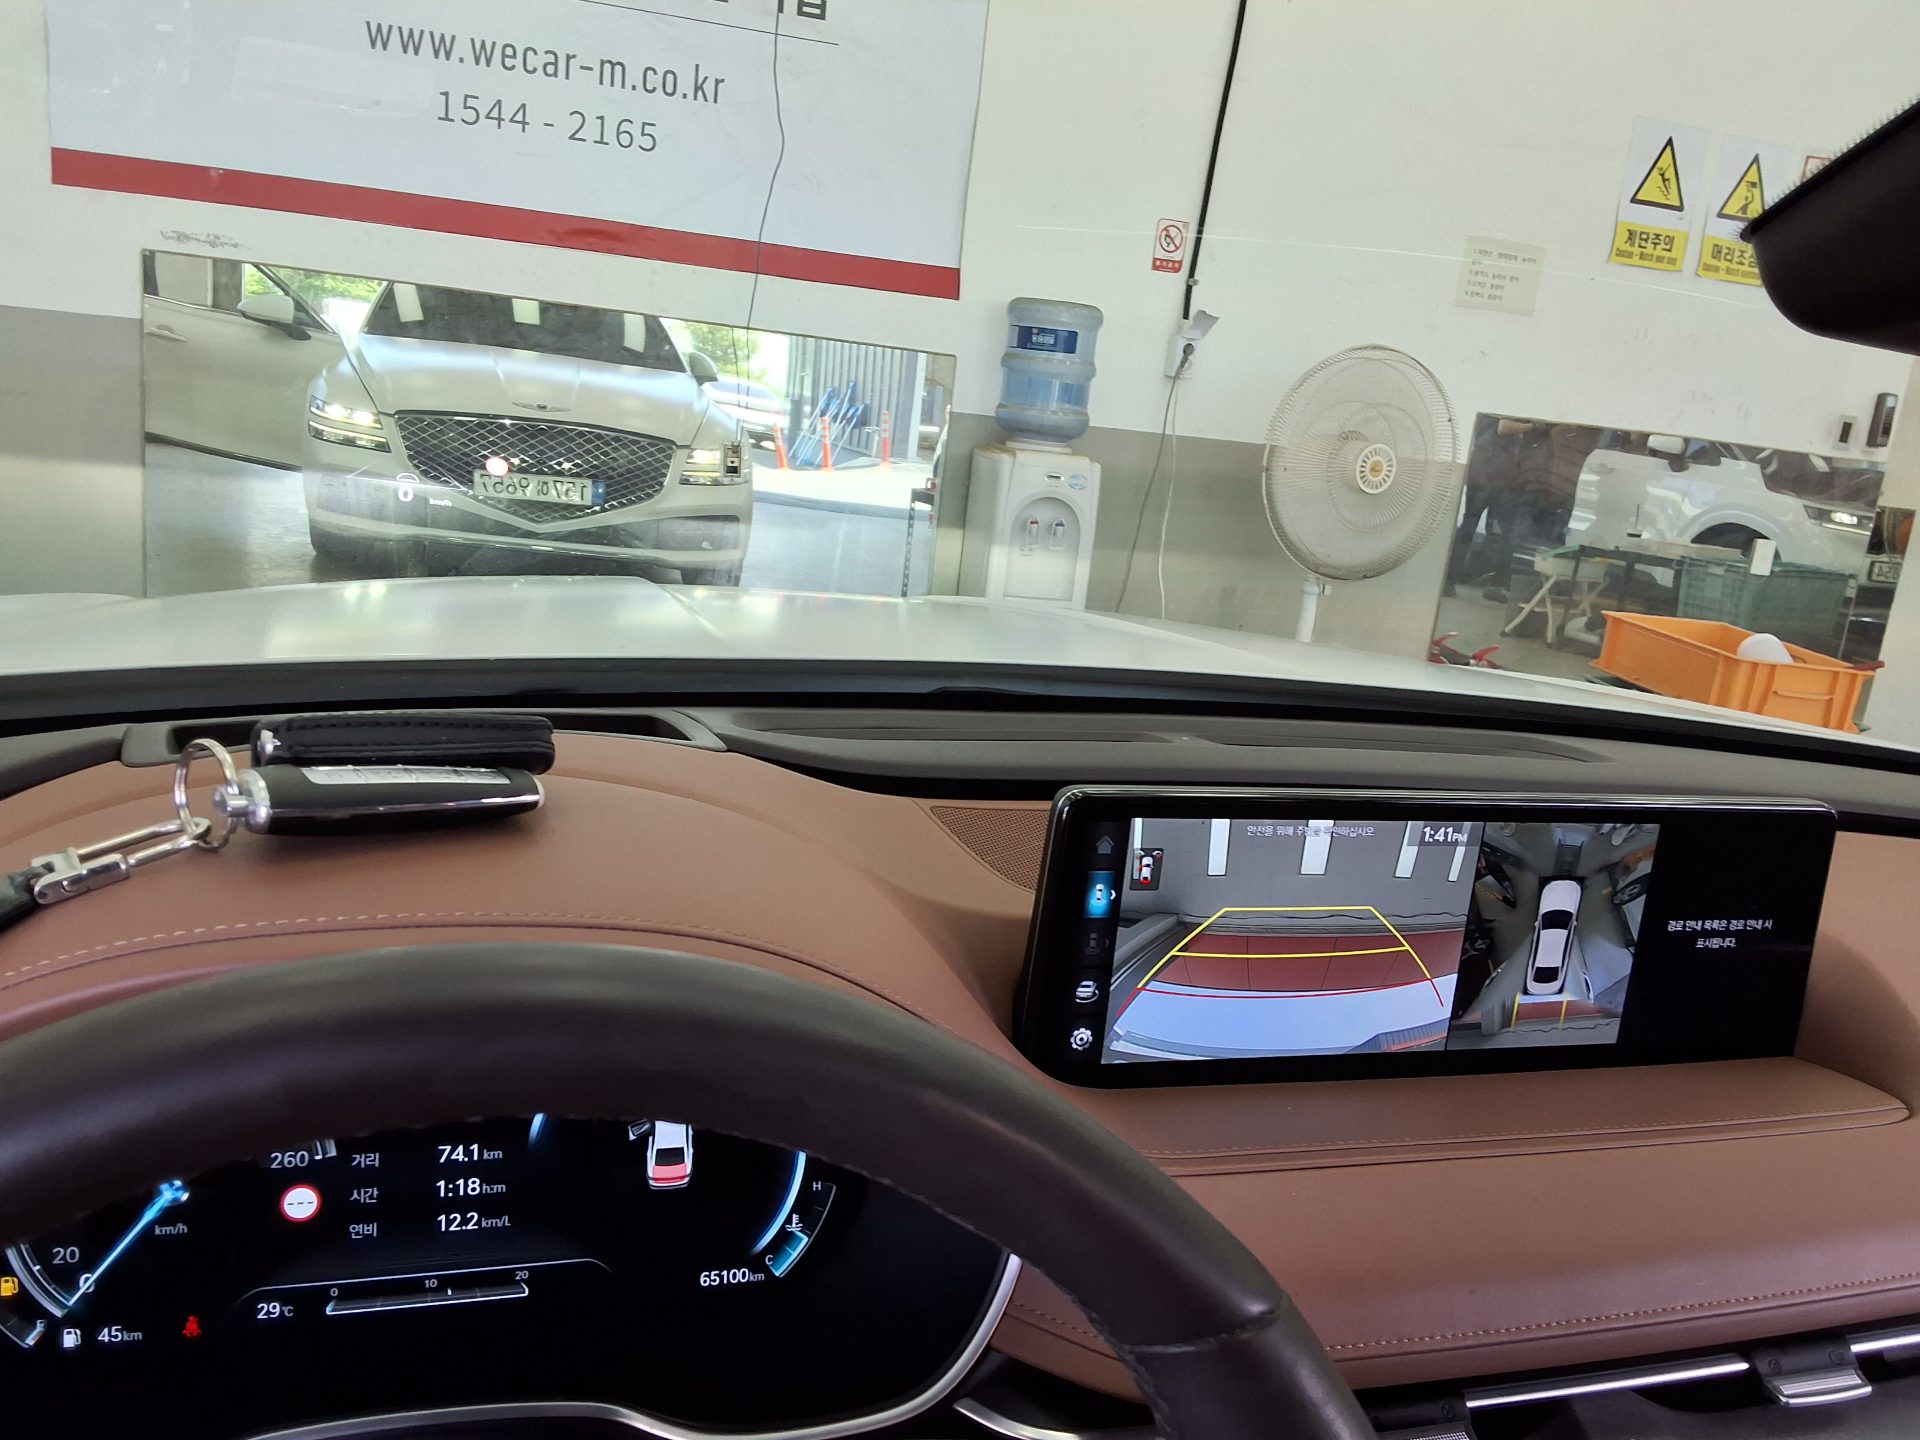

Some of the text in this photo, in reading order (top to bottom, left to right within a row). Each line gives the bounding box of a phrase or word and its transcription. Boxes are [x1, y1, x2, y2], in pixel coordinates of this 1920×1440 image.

[365, 20, 725, 105] www.wecar-m.co.kr
[436, 89, 531, 133] 1544
[567, 110, 659, 153] 2165
[1624, 228, 1675, 252] 계단주의
[1247, 825, 1274, 837] 안전을
[1276, 825, 1294, 836] 위해
[1667, 919, 1773, 931] 경로 안내 목록은 경로 안내 시
[270, 1150, 309, 1169] 260
[351, 1152, 380, 1169] 거리
[812, 1180, 822, 1191] H
[349, 1187, 379, 1204] 시간
[154, 1222, 188, 1236] km/h
[349, 1221, 378, 1239] 연비
[52, 1246, 80, 1264] 20
[765, 1254, 774, 1265] C
[329, 1270, 529, 1297] 0 10 20
